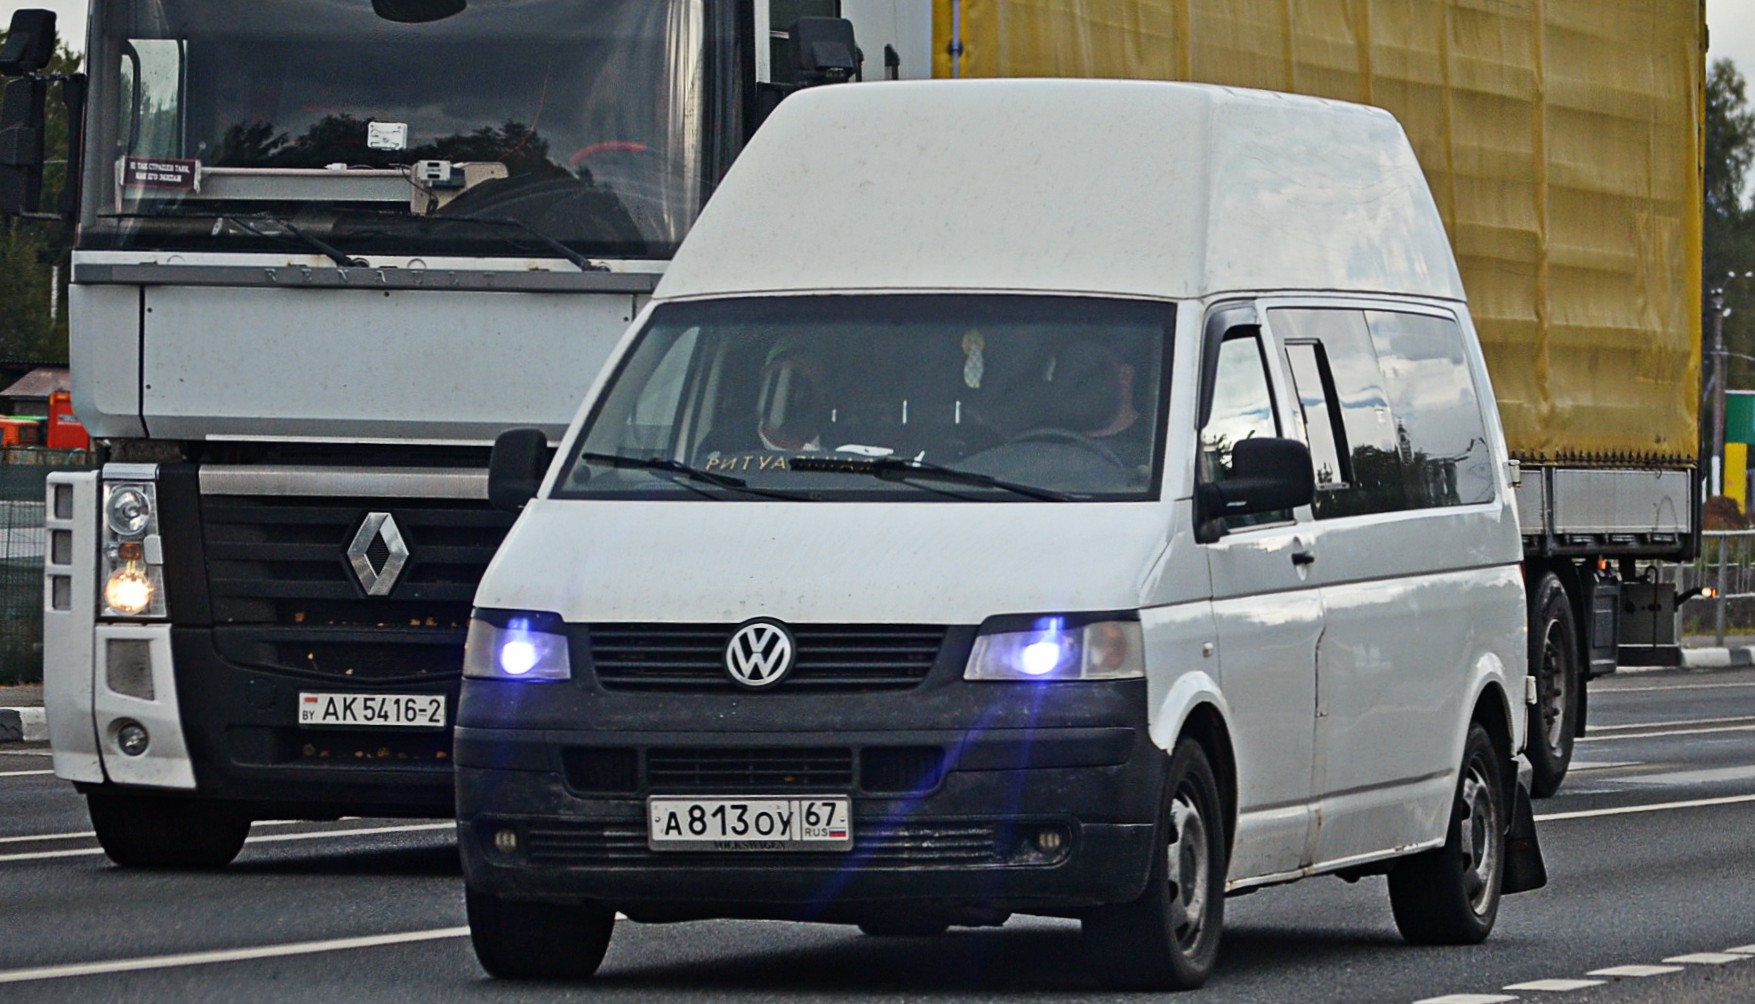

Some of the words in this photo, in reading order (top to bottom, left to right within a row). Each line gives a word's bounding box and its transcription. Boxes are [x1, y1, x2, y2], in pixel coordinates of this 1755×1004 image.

[264, 267, 497, 287] RENAULT
[302, 710, 315, 721] BY
[805, 802, 836, 827] 67
[804, 827, 828, 837] RUS
